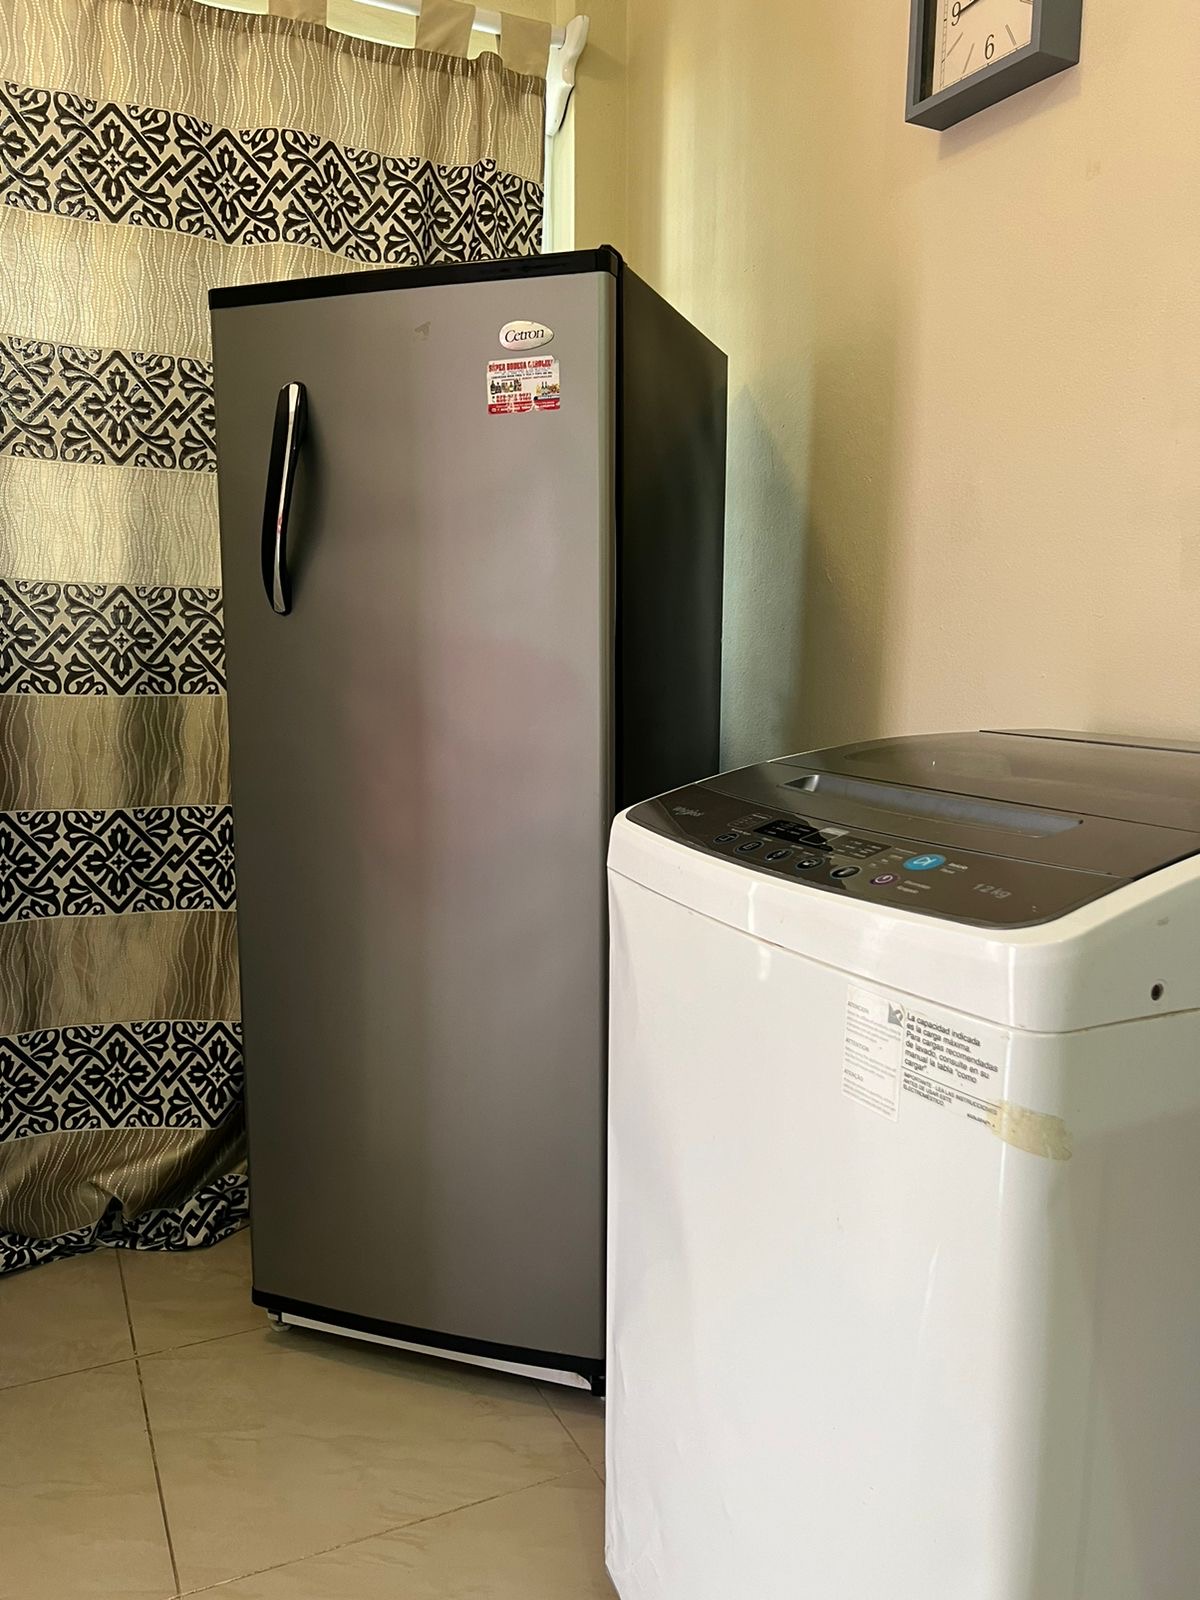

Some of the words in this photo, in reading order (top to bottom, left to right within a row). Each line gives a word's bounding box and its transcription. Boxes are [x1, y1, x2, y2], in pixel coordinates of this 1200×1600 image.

[951, 1, 962, 26] 9
[984, 34, 995, 60] 6
[505, 329, 544, 343] Cetron
[906, 1023, 914, 1031] es
[916, 1025, 922, 1034] la
[923, 1029, 941, 1042] carga
[907, 1012, 915, 1022] La
[916, 1018, 950, 1035] capacidad
[952, 1030, 981, 1047] indicada
[905, 1049, 928, 1064] manual
[930, 1058, 936, 1067] la
[937, 1062, 953, 1074] tabla
[906, 1030, 921, 1042] Para
[922, 1038, 944, 1052] cargas
[946, 1047, 998, 1073] recomendadas
[906, 1040, 914, 1049] de
[939, 1054, 968, 1070] consulte
[969, 1066, 979, 1075] en
[980, 1070, 990, 1080] su
